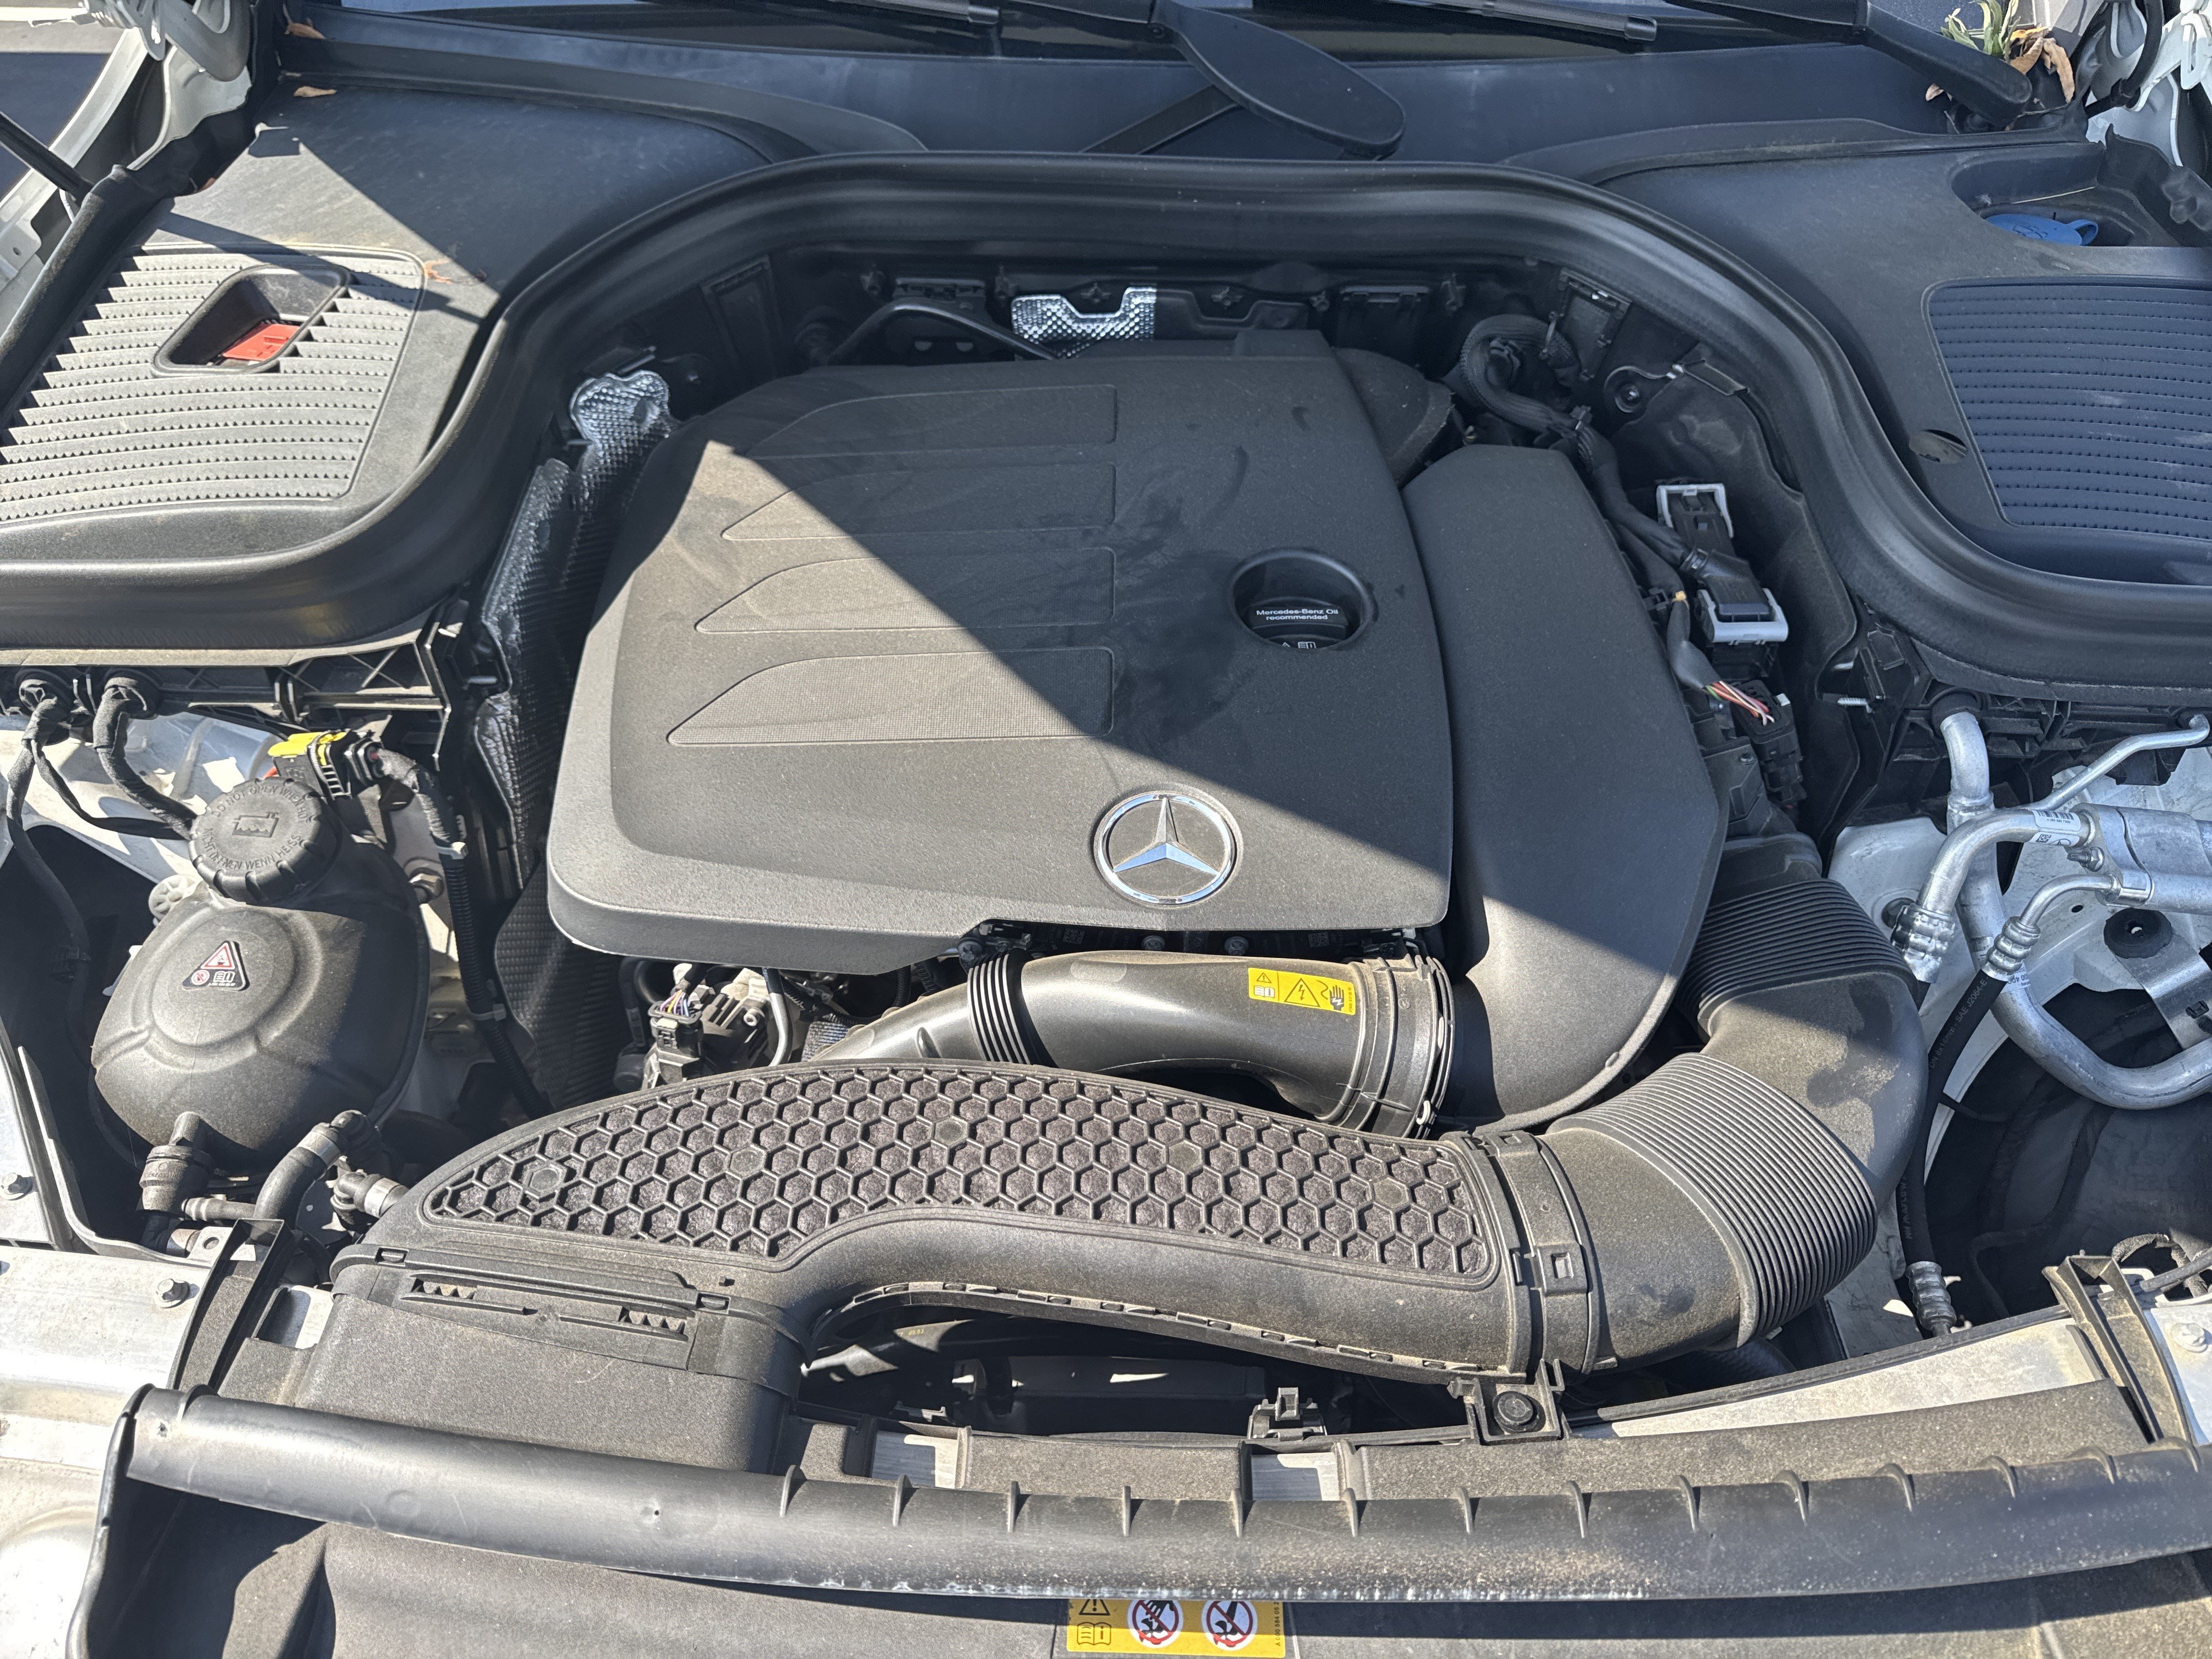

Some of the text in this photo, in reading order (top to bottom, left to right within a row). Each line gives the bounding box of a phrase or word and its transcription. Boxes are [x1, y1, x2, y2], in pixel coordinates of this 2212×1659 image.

[211, 786, 308, 823] DO NOT OPEN WHEN HOT
[245, 855, 275, 870] WENN
[276, 834, 301, 857] HEISS
[1955, 1006, 1969, 1023] SAE
[1966, 978, 1988, 1007] J2064-E
